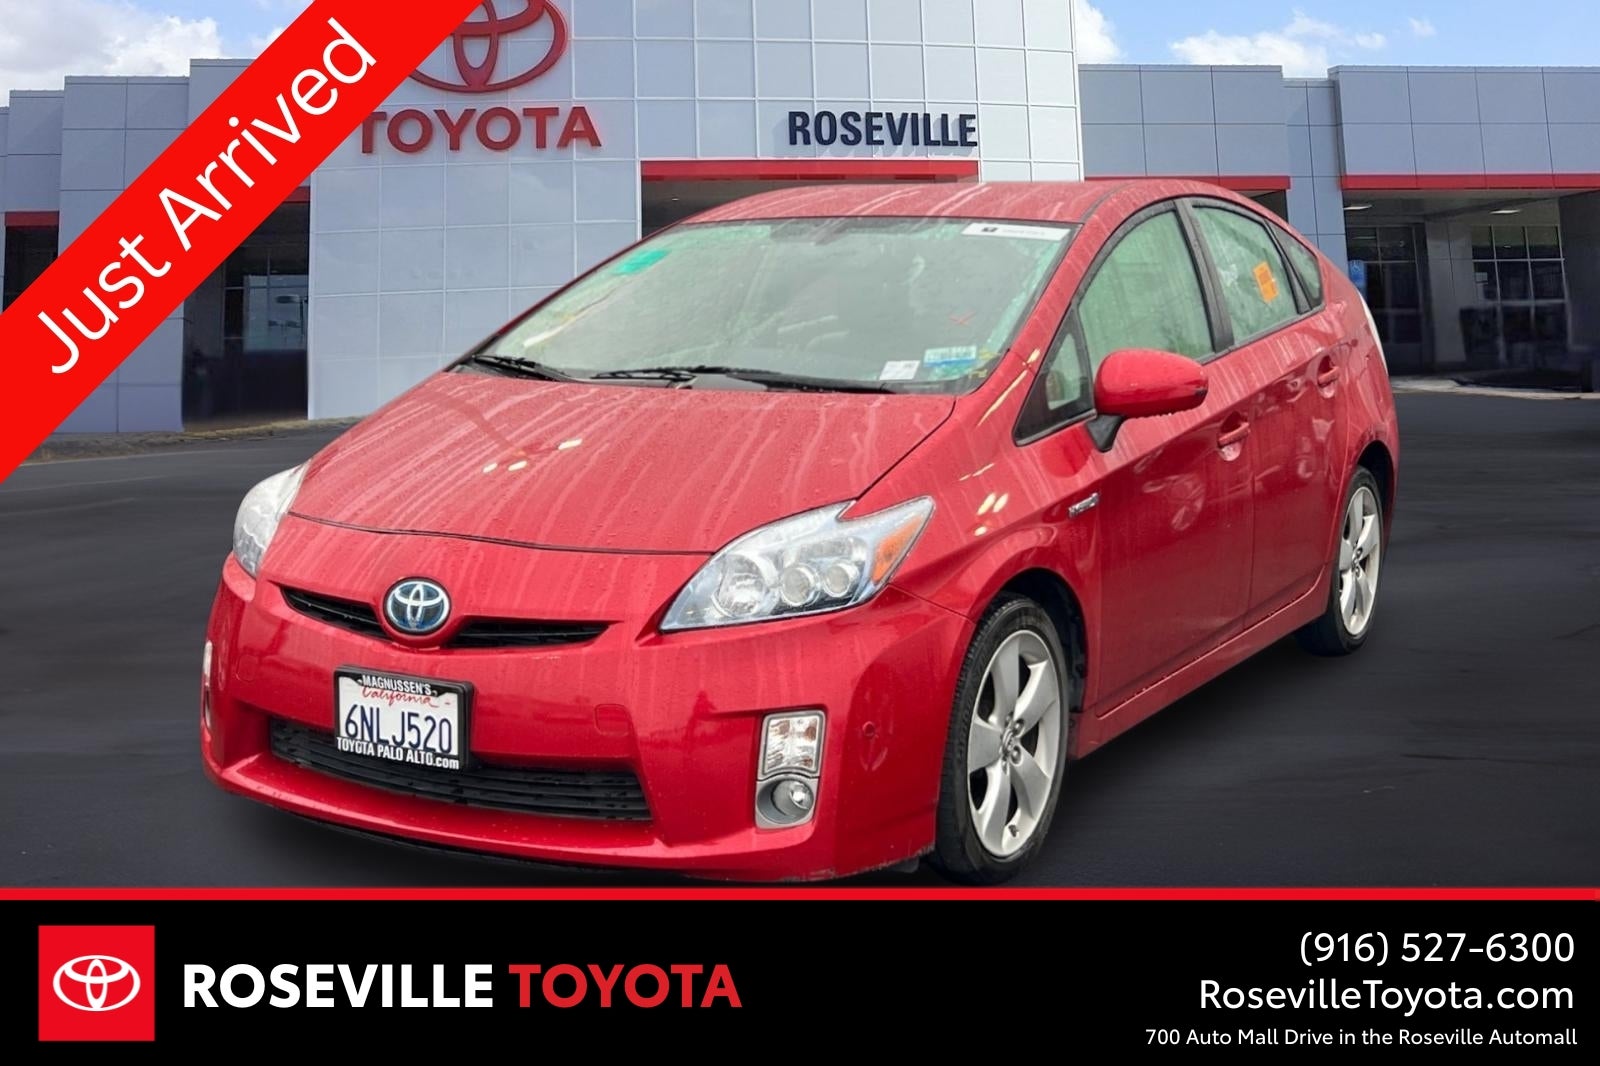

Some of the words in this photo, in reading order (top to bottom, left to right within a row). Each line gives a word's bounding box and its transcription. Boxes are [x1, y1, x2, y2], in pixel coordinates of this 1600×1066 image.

[362, 107, 602, 154] TOYOTA
[788, 111, 978, 147] ROSEVILLE
[362, 675, 432, 696] MAGNUSSEN'S
[362, 686, 439, 707] California
[345, 704, 452, 754] 6NLJ520
[336, 737, 375, 756] TOYOTA
[377, 744, 404, 761] PALO
[406, 751, 460, 770] ALTO.com
